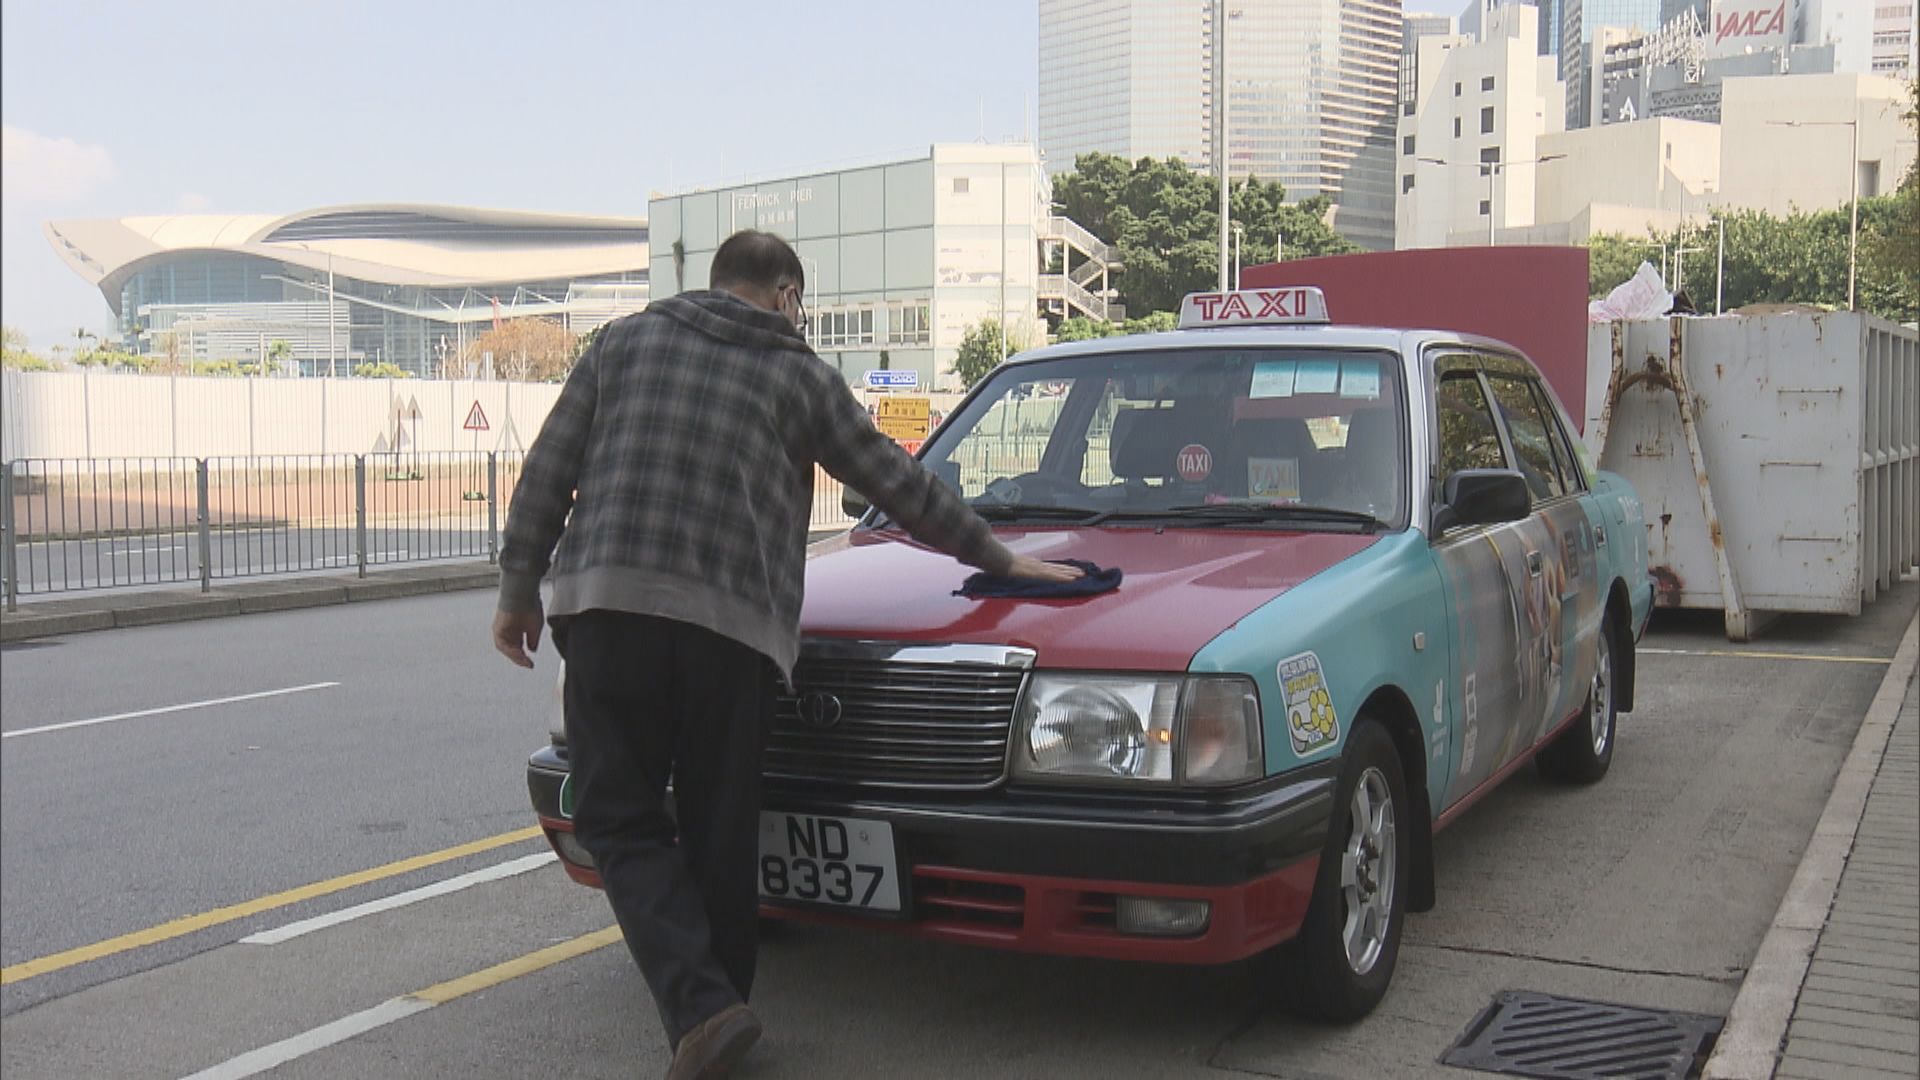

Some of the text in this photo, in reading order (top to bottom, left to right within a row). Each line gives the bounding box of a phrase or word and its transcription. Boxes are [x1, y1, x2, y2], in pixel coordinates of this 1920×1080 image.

[1715, 0, 1785, 46] YMCA
[738, 187, 813, 210] FENWICK PIER
[1193, 290, 1306, 321] TAXI
[1181, 453, 1208, 473] TAXI
[786, 816, 849, 861] ND
[761, 854, 884, 906] 8337
